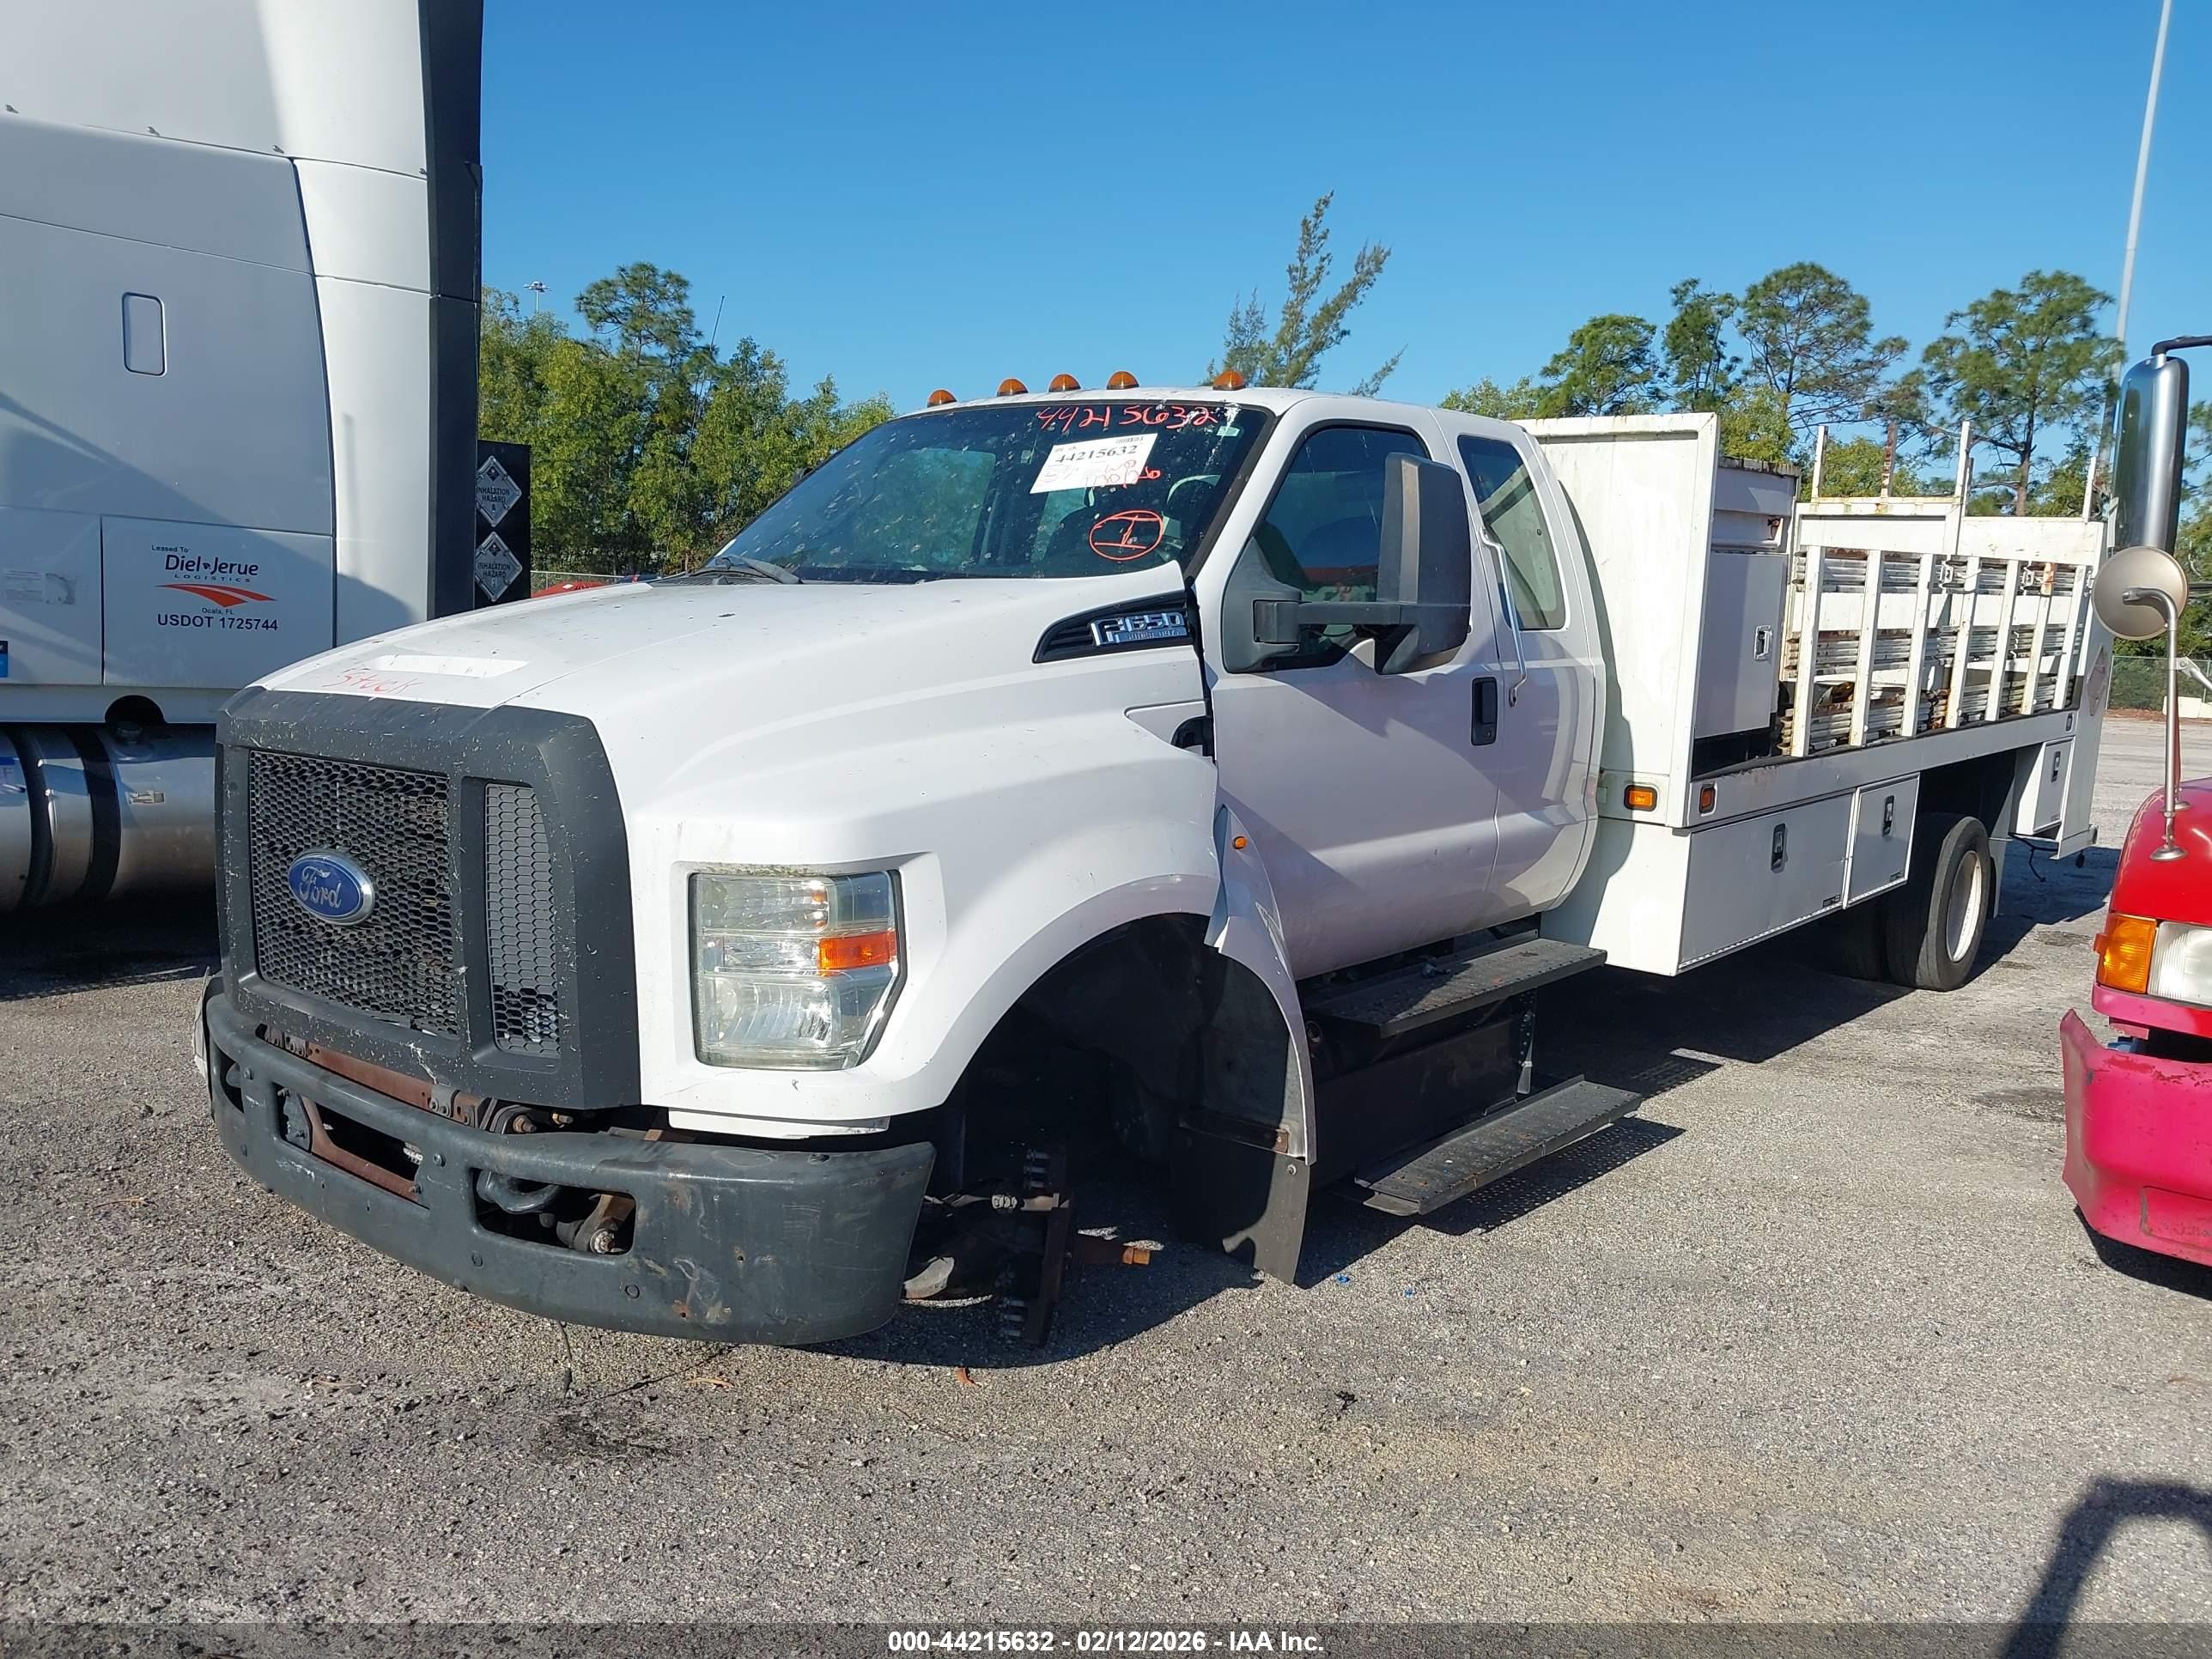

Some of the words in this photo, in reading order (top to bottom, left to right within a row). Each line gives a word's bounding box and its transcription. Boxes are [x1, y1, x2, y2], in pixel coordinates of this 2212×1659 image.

[1055, 445, 1138, 463] 44215632
[477, 486, 510, 495] INHALATION
[482, 495, 507, 503] HAZARD
[151, 544, 178, 553] Leased
[477, 562, 511, 571] INHALATION
[174, 574, 251, 583] LOGISTICS
[483, 569, 507, 579] HAZARD
[157, 613, 214, 629] USDOT
[219, 617, 278, 631] 1725744
[299, 866, 342, 908] Ford
